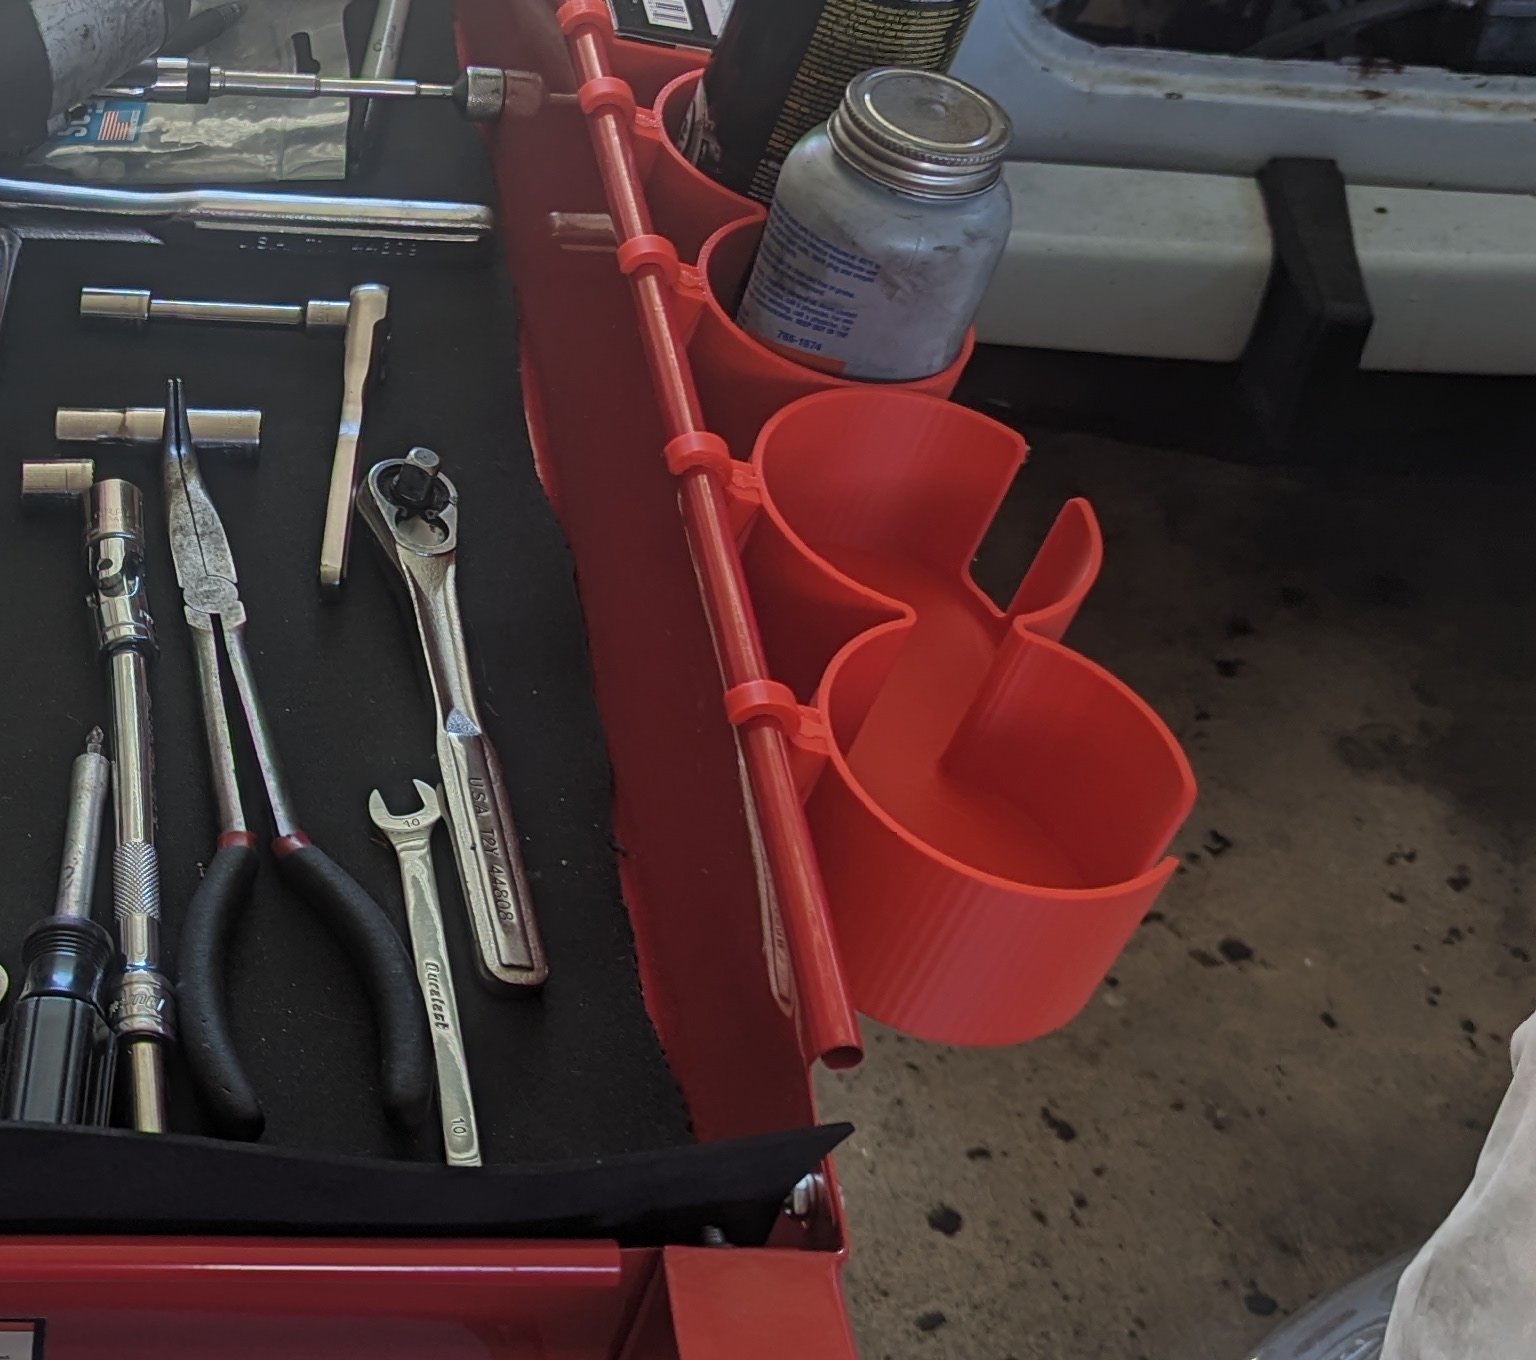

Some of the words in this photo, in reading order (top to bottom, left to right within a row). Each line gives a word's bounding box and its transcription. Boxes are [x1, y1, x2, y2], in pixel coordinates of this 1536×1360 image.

[402, 818, 420, 828] 10
[487, 862, 515, 922] 44808
[450, 1117, 467, 1135] 10
